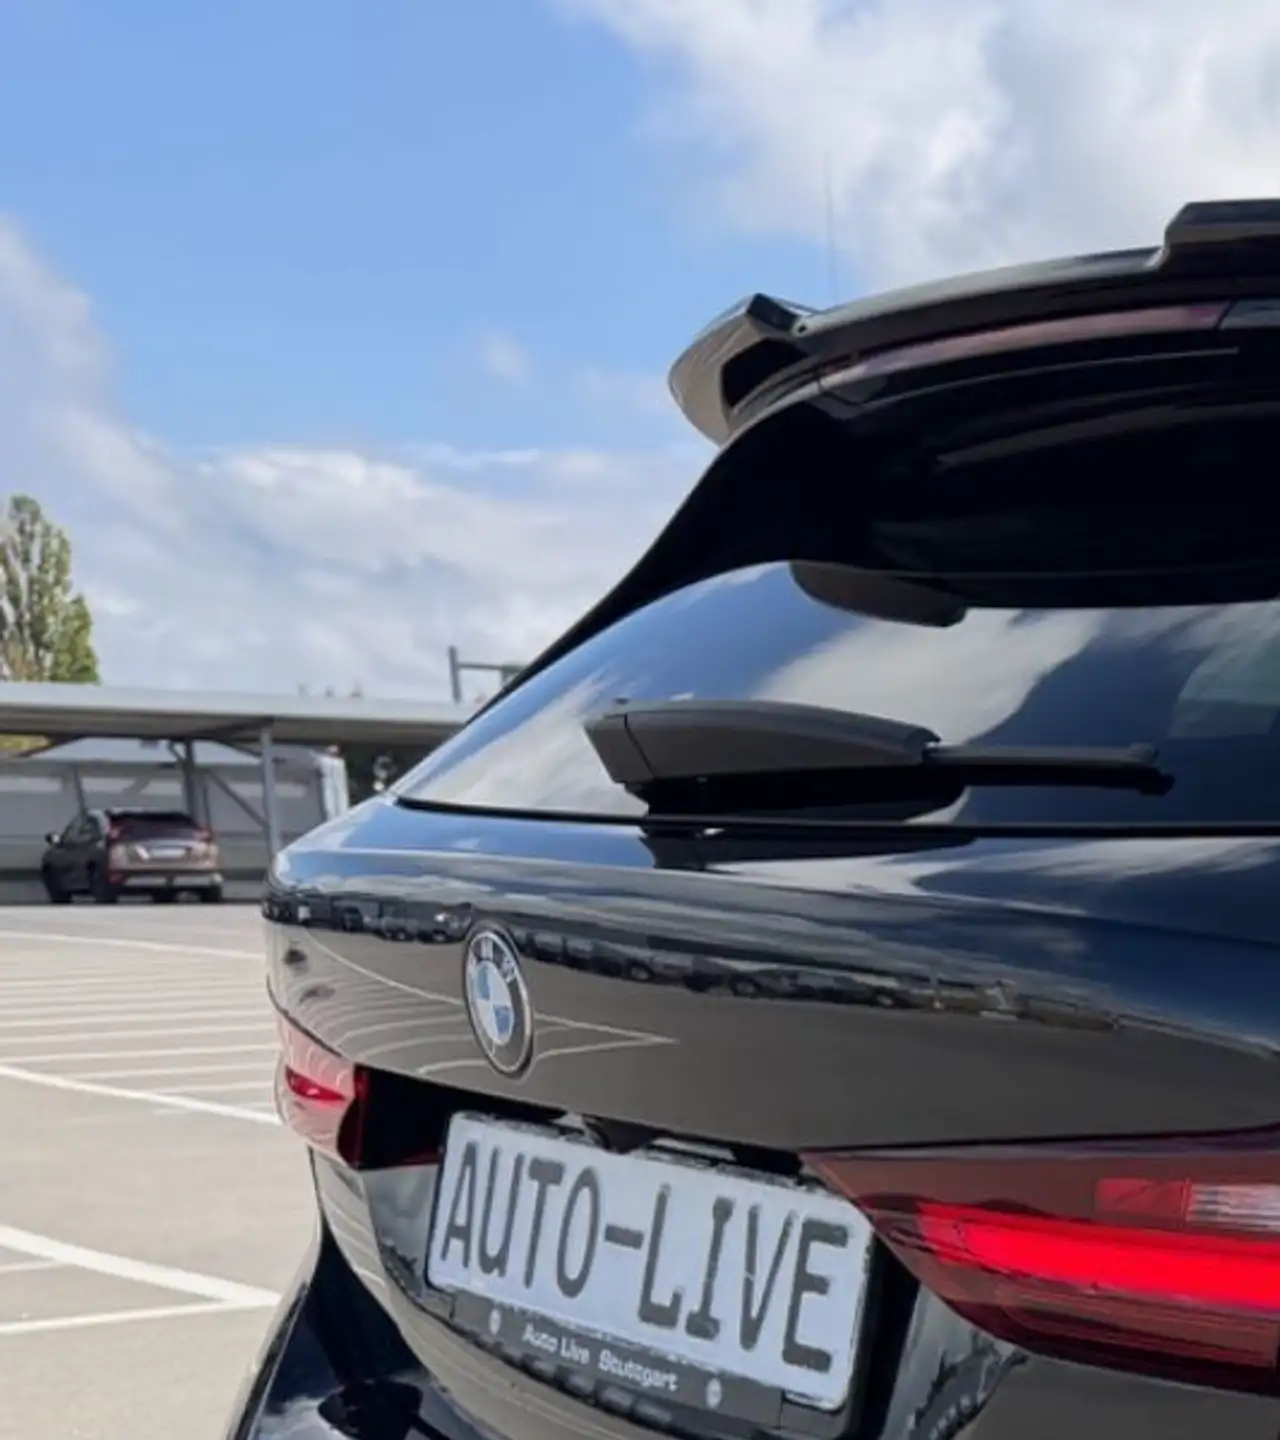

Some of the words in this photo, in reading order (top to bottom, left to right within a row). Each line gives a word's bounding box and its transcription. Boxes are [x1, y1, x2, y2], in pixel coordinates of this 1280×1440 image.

[441, 1141, 849, 1373] AUTO-LIVE
[523, 1323, 558, 1353] Auto
[561, 1336, 590, 1364] Live
[598, 1350, 678, 1392] Stuttgart
